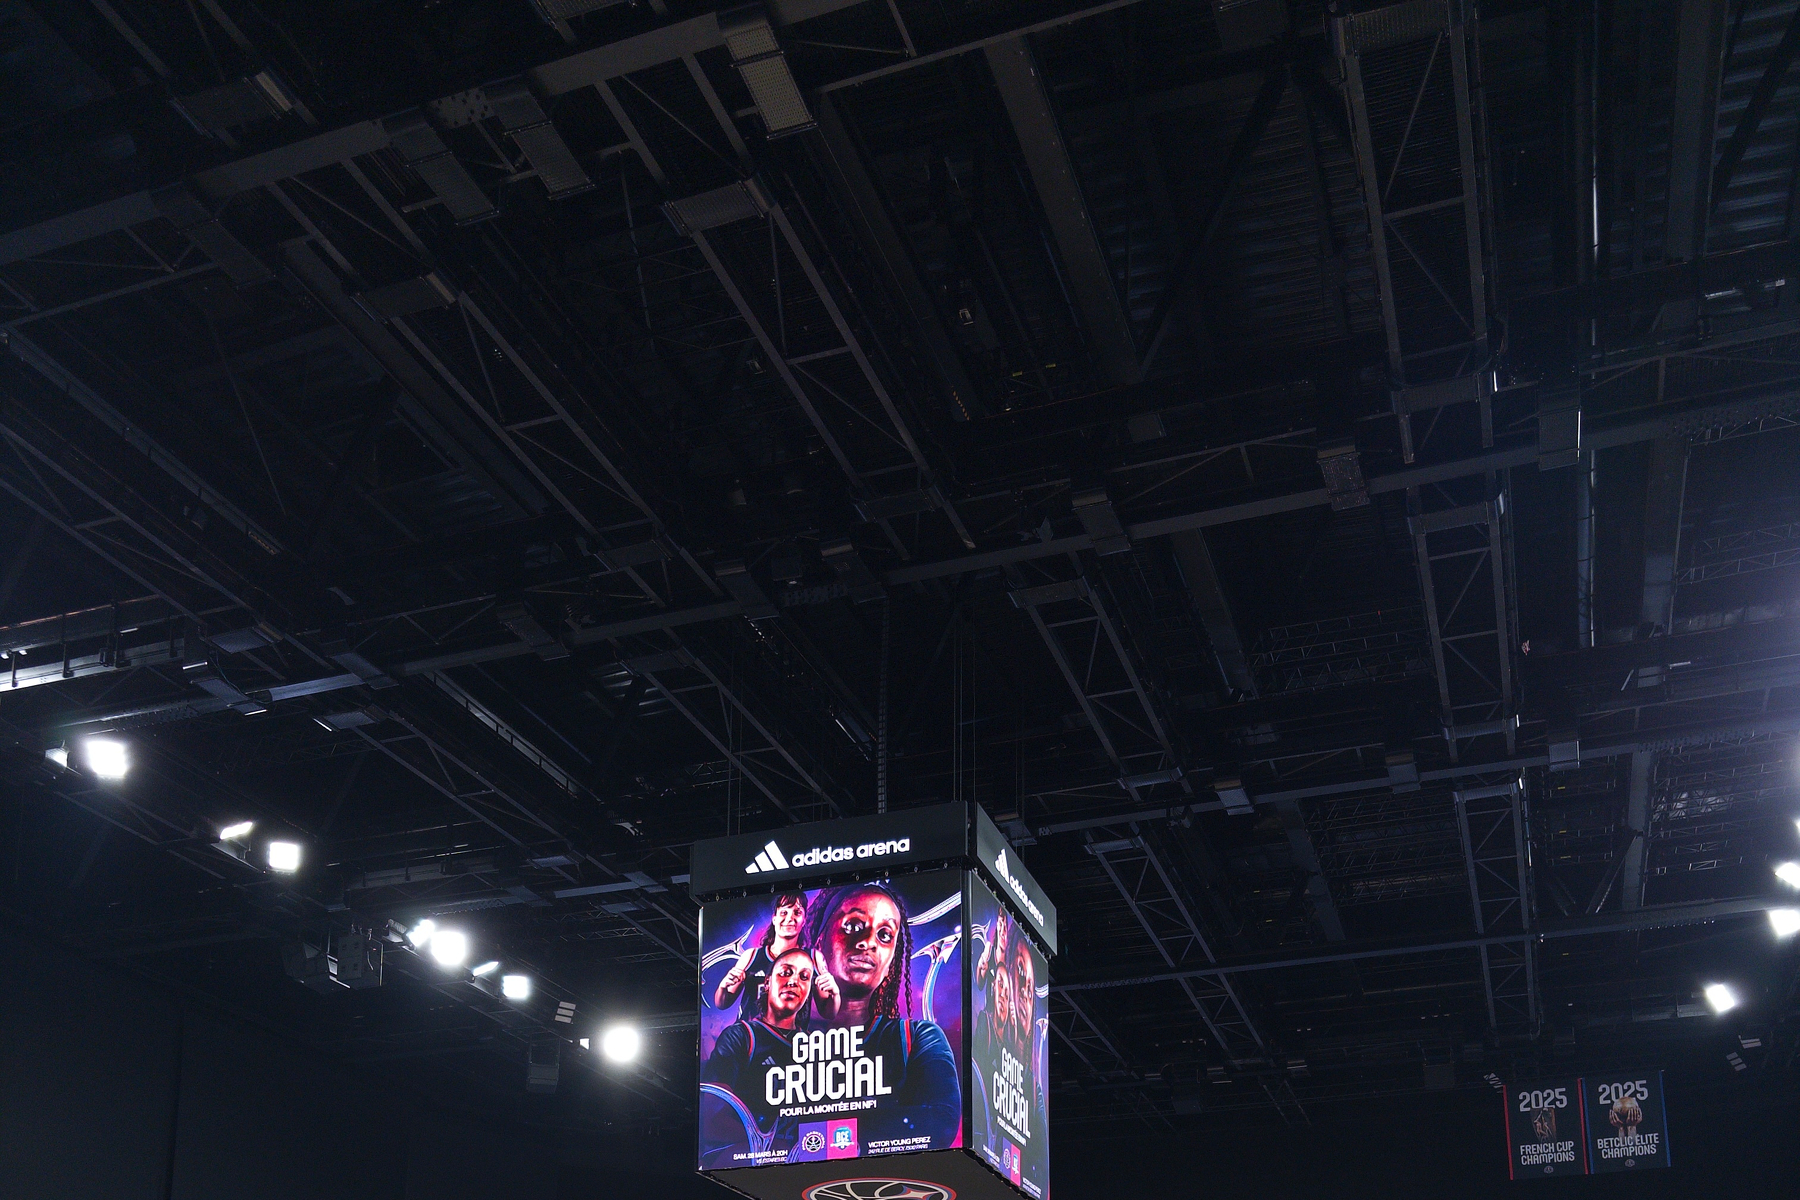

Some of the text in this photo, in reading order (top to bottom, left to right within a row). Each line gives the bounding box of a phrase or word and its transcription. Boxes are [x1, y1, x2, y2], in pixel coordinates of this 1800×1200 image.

[792, 837, 911, 868] adidas arena
[792, 1025, 865, 1063] GAME
[765, 1055, 892, 1106] CRUCIAL
[1001, 1047, 1024, 1094] GAME
[992, 1070, 1031, 1139] CRUCIAL
[1518, 1087, 1568, 1112] 2025
[1599, 1079, 1649, 1105] 2025
[779, 1107, 803, 1118] POUR
[802, 1106, 815, 1116] LA
[814, 1101, 850, 1114] MONTÉE
[850, 1101, 863, 1111] EN
[868, 1140, 890, 1149] VICTOR
[889, 1138, 911, 1146] YOUNG
[911, 1135, 931, 1144] PEREZ
[1520, 1140, 1575, 1156] FRENCH CUP
[1597, 1135, 1634, 1150] BETCLIC
[1601, 1143, 1658, 1159] CHAMPIONS
[1521, 1150, 1575, 1166] CHAMPIONS
